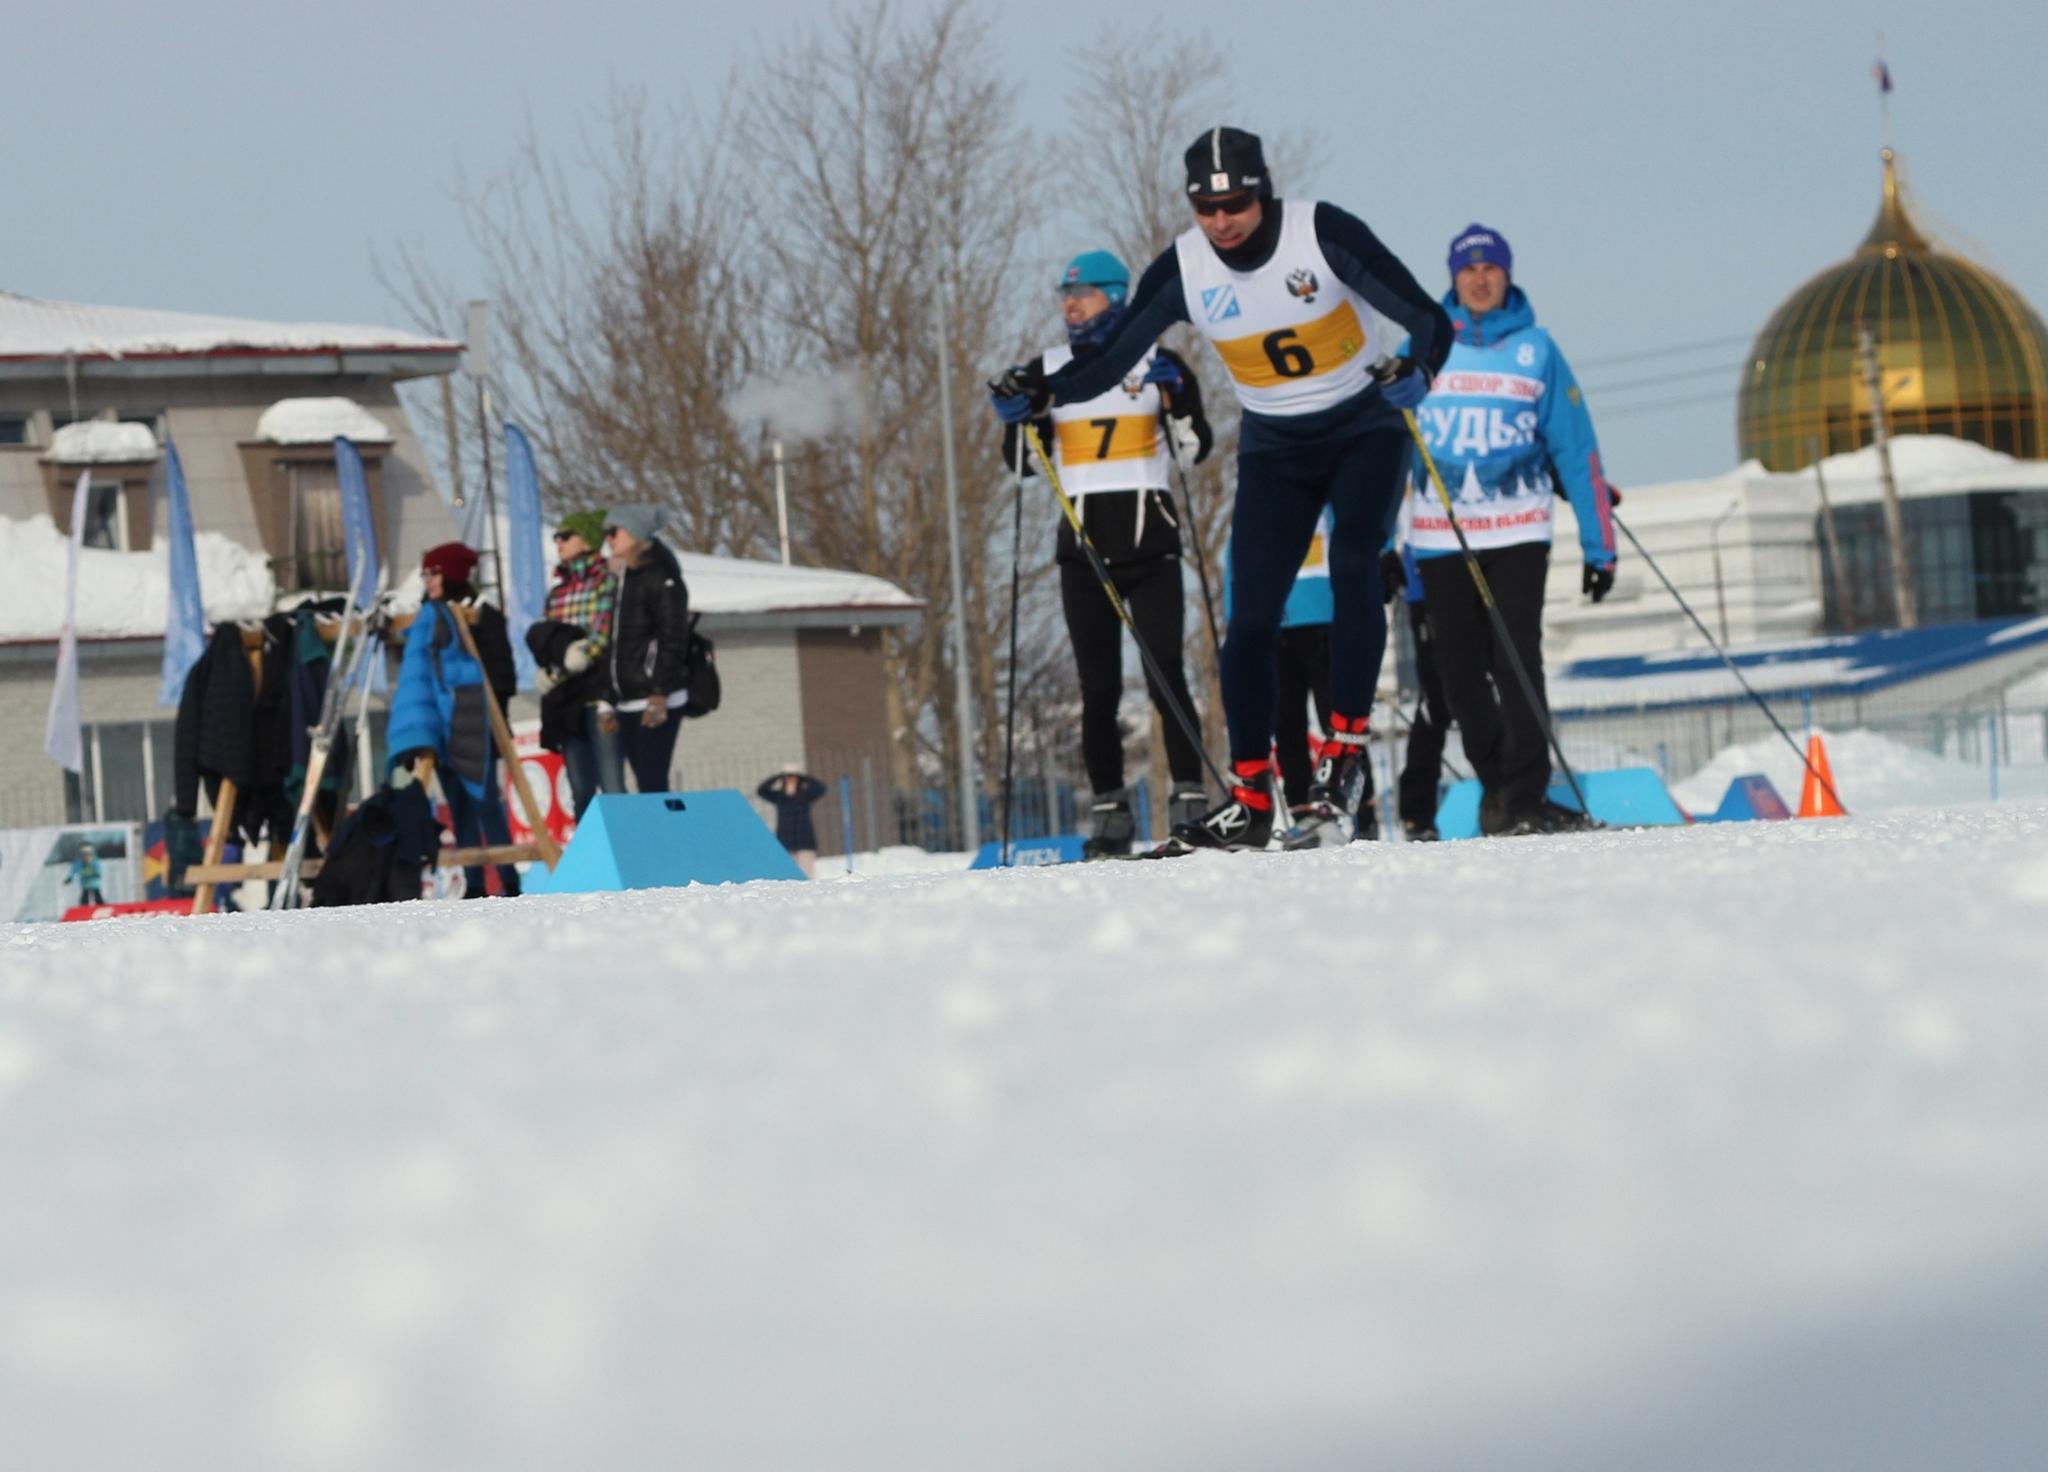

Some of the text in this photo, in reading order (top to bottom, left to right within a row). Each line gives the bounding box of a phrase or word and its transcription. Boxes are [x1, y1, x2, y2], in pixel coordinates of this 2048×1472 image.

[1263, 328, 1315, 378] 6
[1516, 343, 1536, 366] 8
[1090, 417, 1117, 460] 7
[1416, 406, 1538, 456] СУДЬЯ
